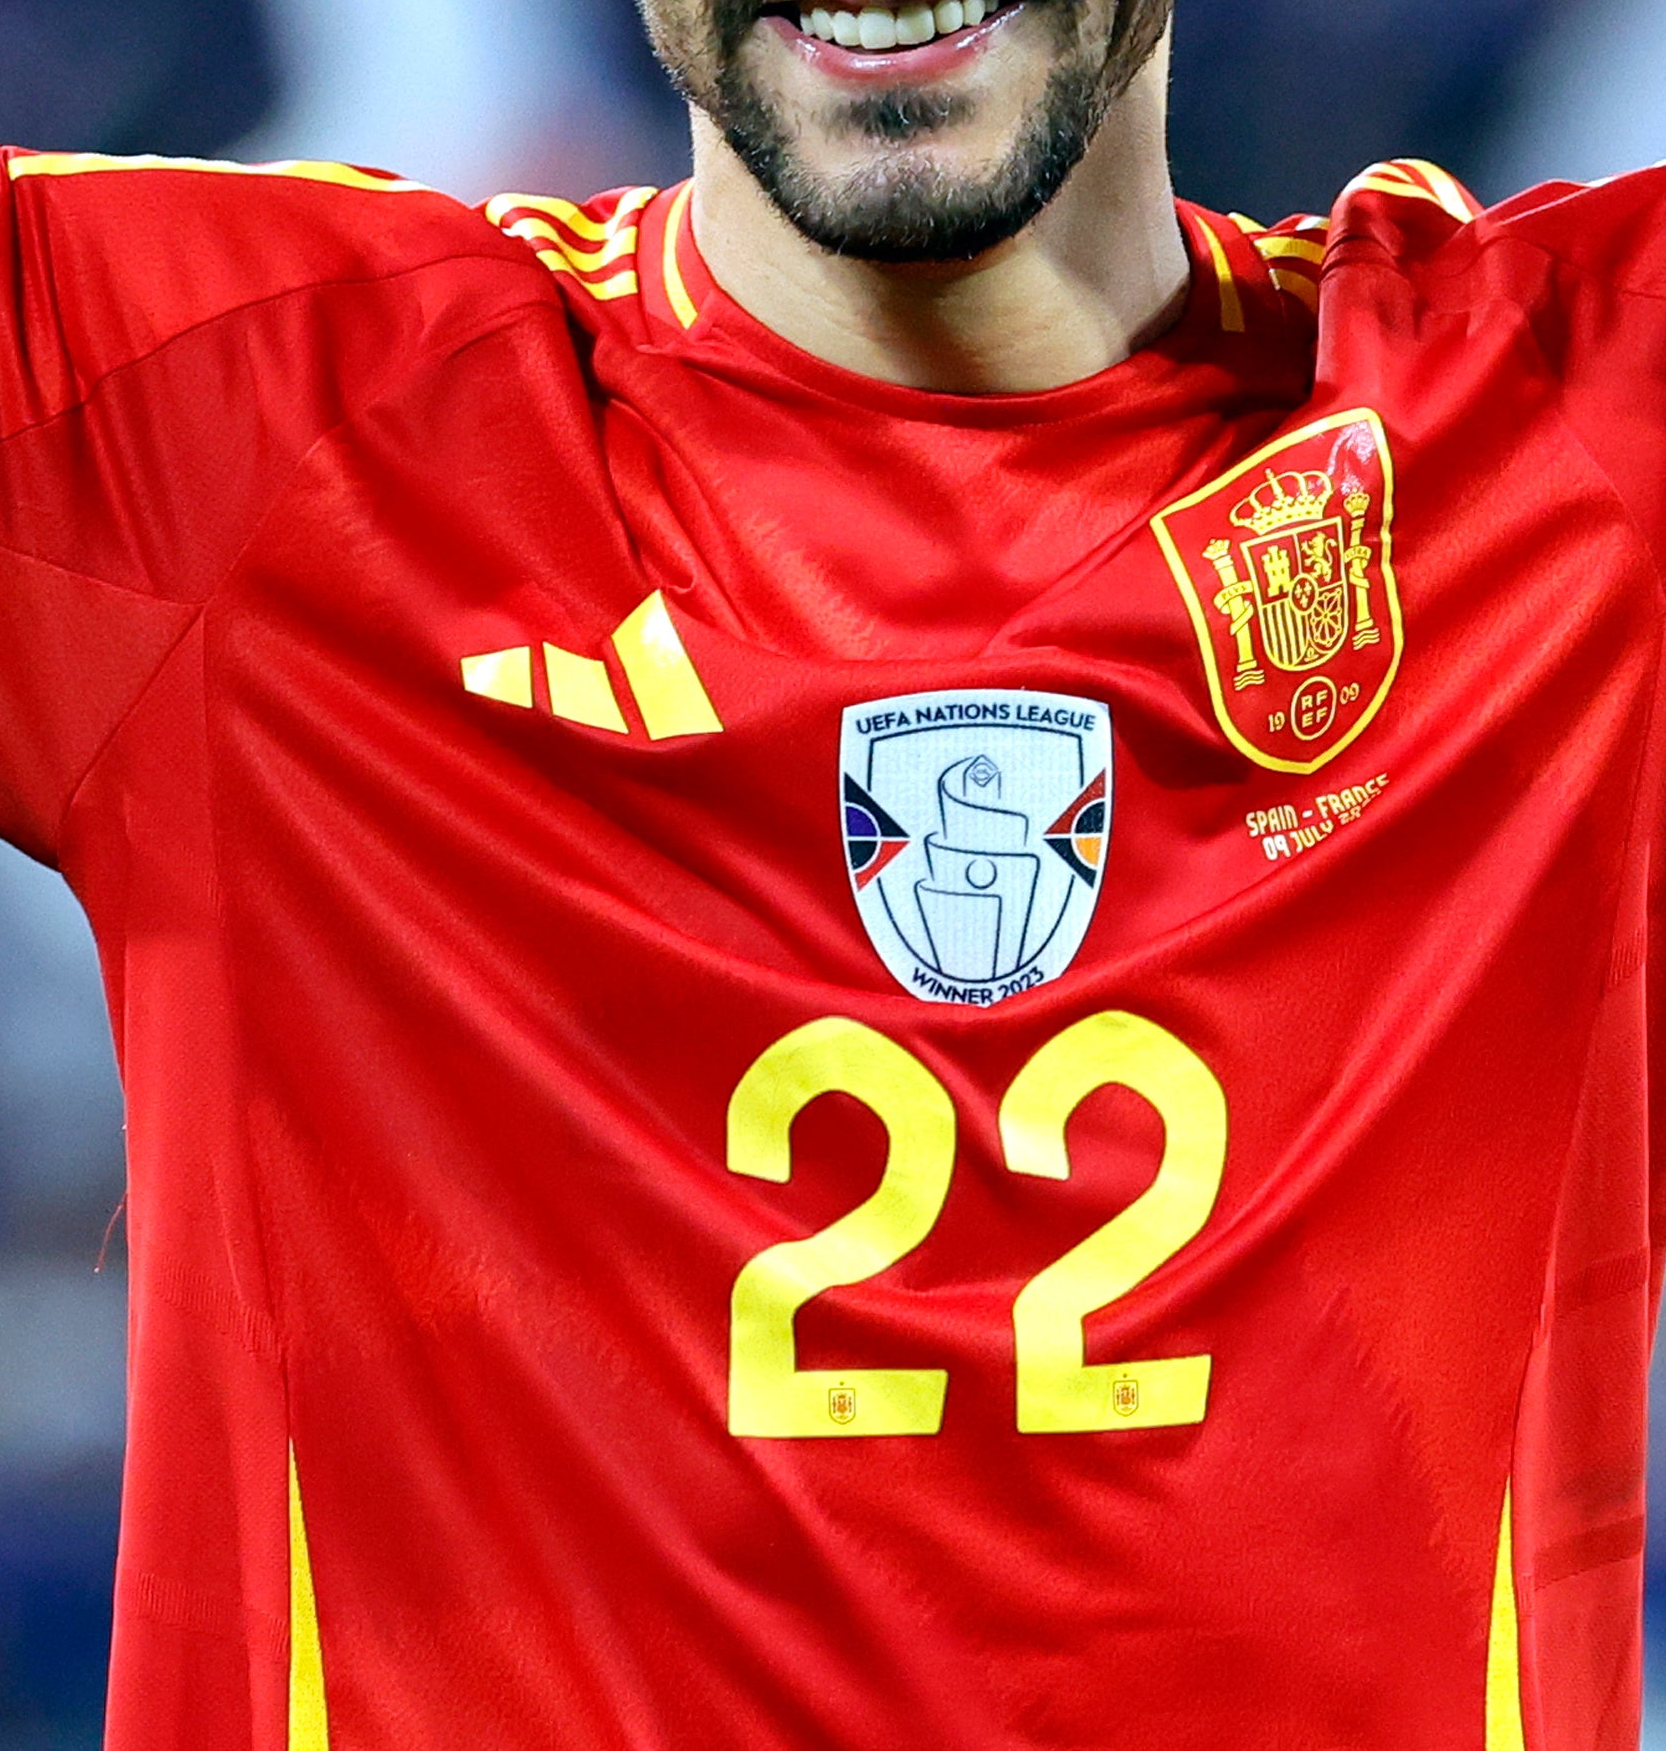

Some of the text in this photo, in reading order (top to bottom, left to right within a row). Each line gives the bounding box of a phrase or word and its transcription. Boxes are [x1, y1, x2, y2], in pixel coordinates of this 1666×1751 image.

[856, 703, 1096, 734] UEFA NATIONS LEAGUE
[1268, 711, 1286, 733] 19
[1245, 804, 1299, 837] SPAIN
[1261, 834, 1292, 861] 09
[912, 965, 1045, 1005] WINNER 2023
[726, 1010, 1228, 1439] 22
